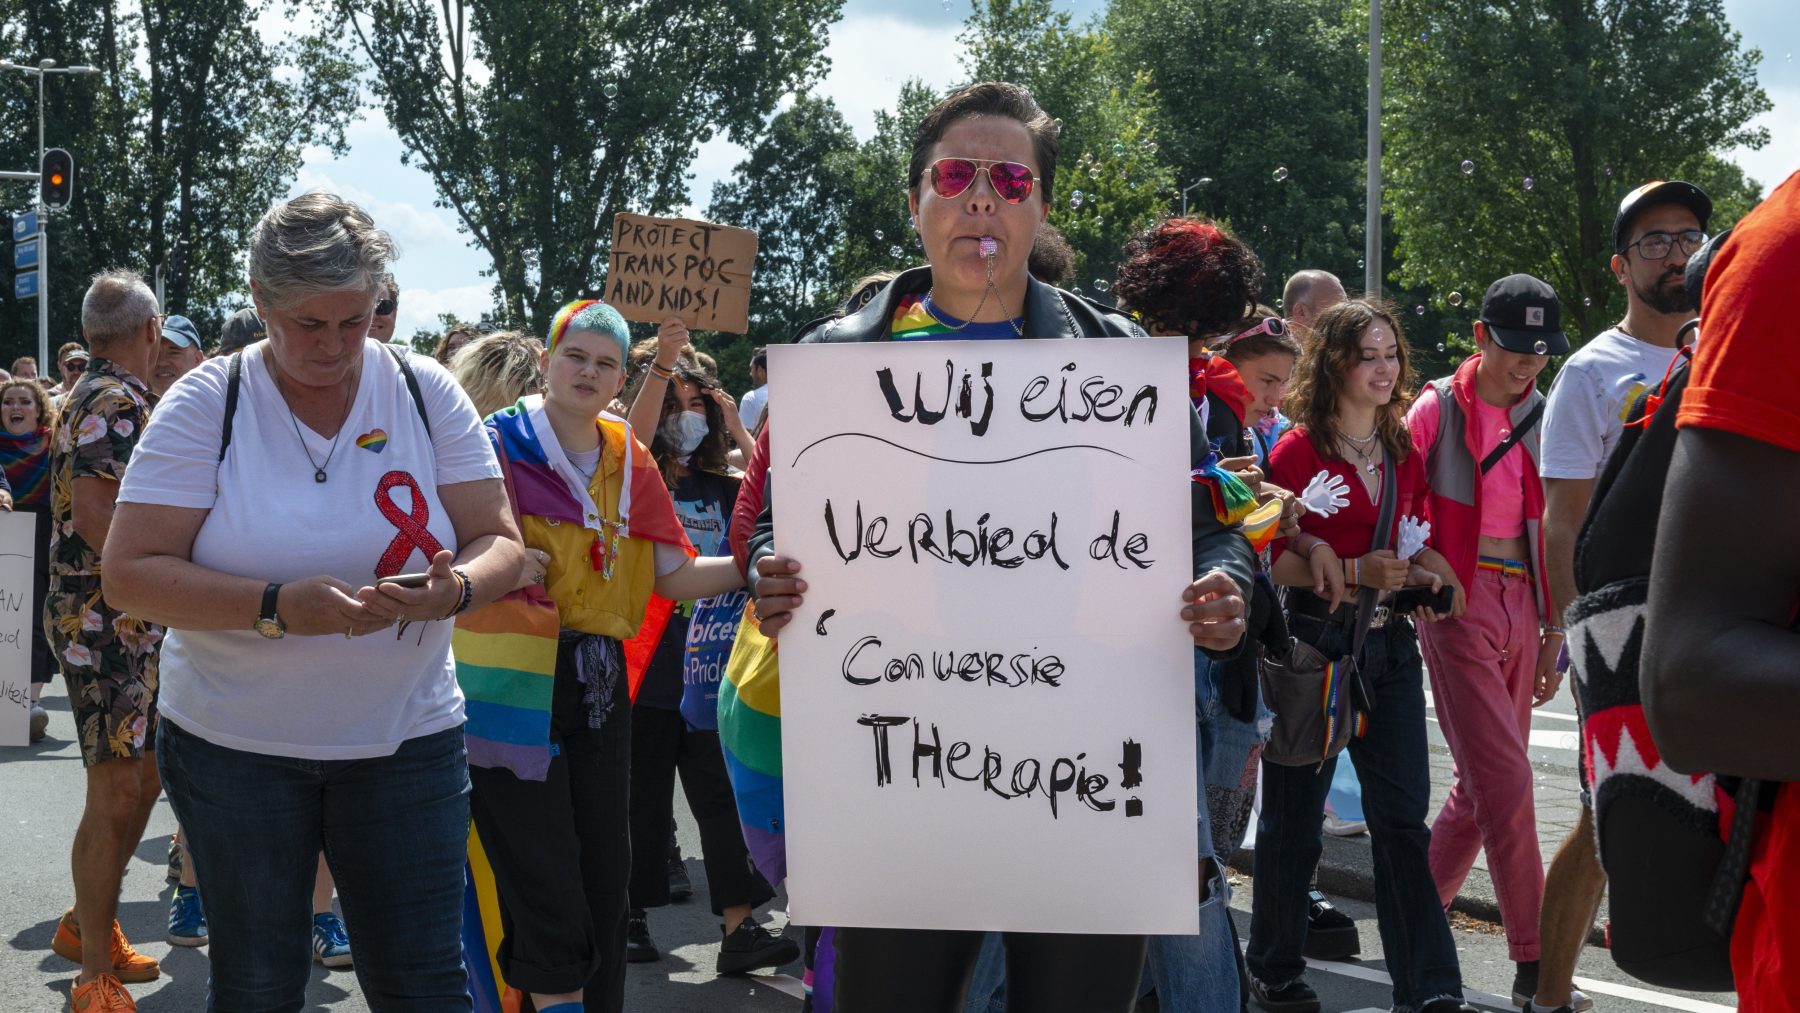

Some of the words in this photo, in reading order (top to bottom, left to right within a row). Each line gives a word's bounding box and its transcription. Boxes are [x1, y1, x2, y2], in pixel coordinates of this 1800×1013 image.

[617, 219, 721, 256] PROTECT
[612, 251, 677, 278] TRANS
[684, 255, 734, 284] POC
[611, 278, 654, 306] AND
[658, 284, 719, 320] KIDS!
[876, 360, 994, 436] Wij
[1020, 362, 1157, 427] eisen
[1090, 510, 1154, 569] de
